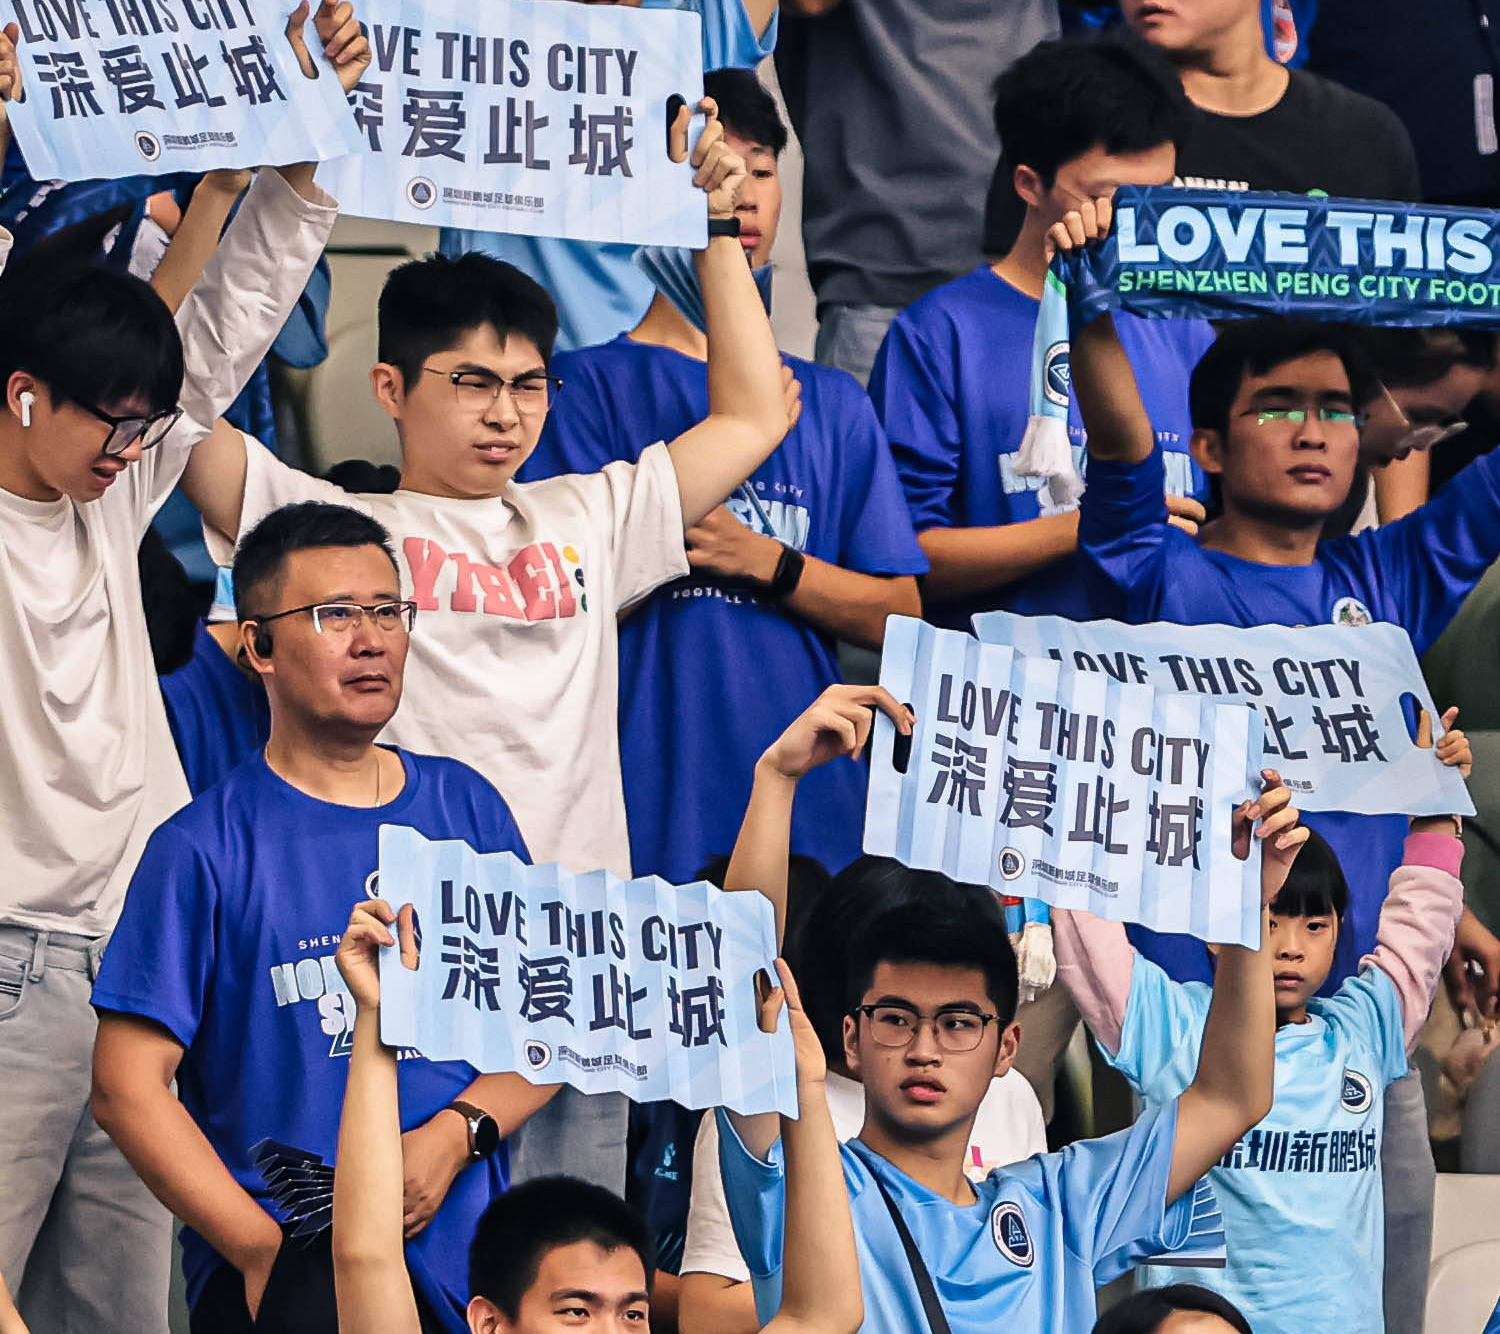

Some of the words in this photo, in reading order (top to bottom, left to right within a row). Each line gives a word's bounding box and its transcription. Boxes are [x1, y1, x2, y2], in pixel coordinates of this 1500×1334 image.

[32, 35, 287, 119] 深爱此城
[436, 32, 530, 88] THIS
[548, 43, 638, 96] CITY
[1117, 205, 1308, 264] LOVE
[1326, 210, 1493, 274] THIS
[1118, 269, 1268, 294] SHENZHEN
[1276, 271, 1350, 296] PENG
[1358, 275, 1424, 299] CITY
[935, 673, 1022, 737] LOVE
[1036, 691, 1115, 769] THIS
[1131, 727, 1210, 789] CITY
[926, 732, 1207, 873] 深爱此城
[441, 880, 527, 947] LOVE
[541, 901, 625, 960] THIS
[641, 915, 722, 970] CITY
[441, 935, 727, 1048] 深爱此城
